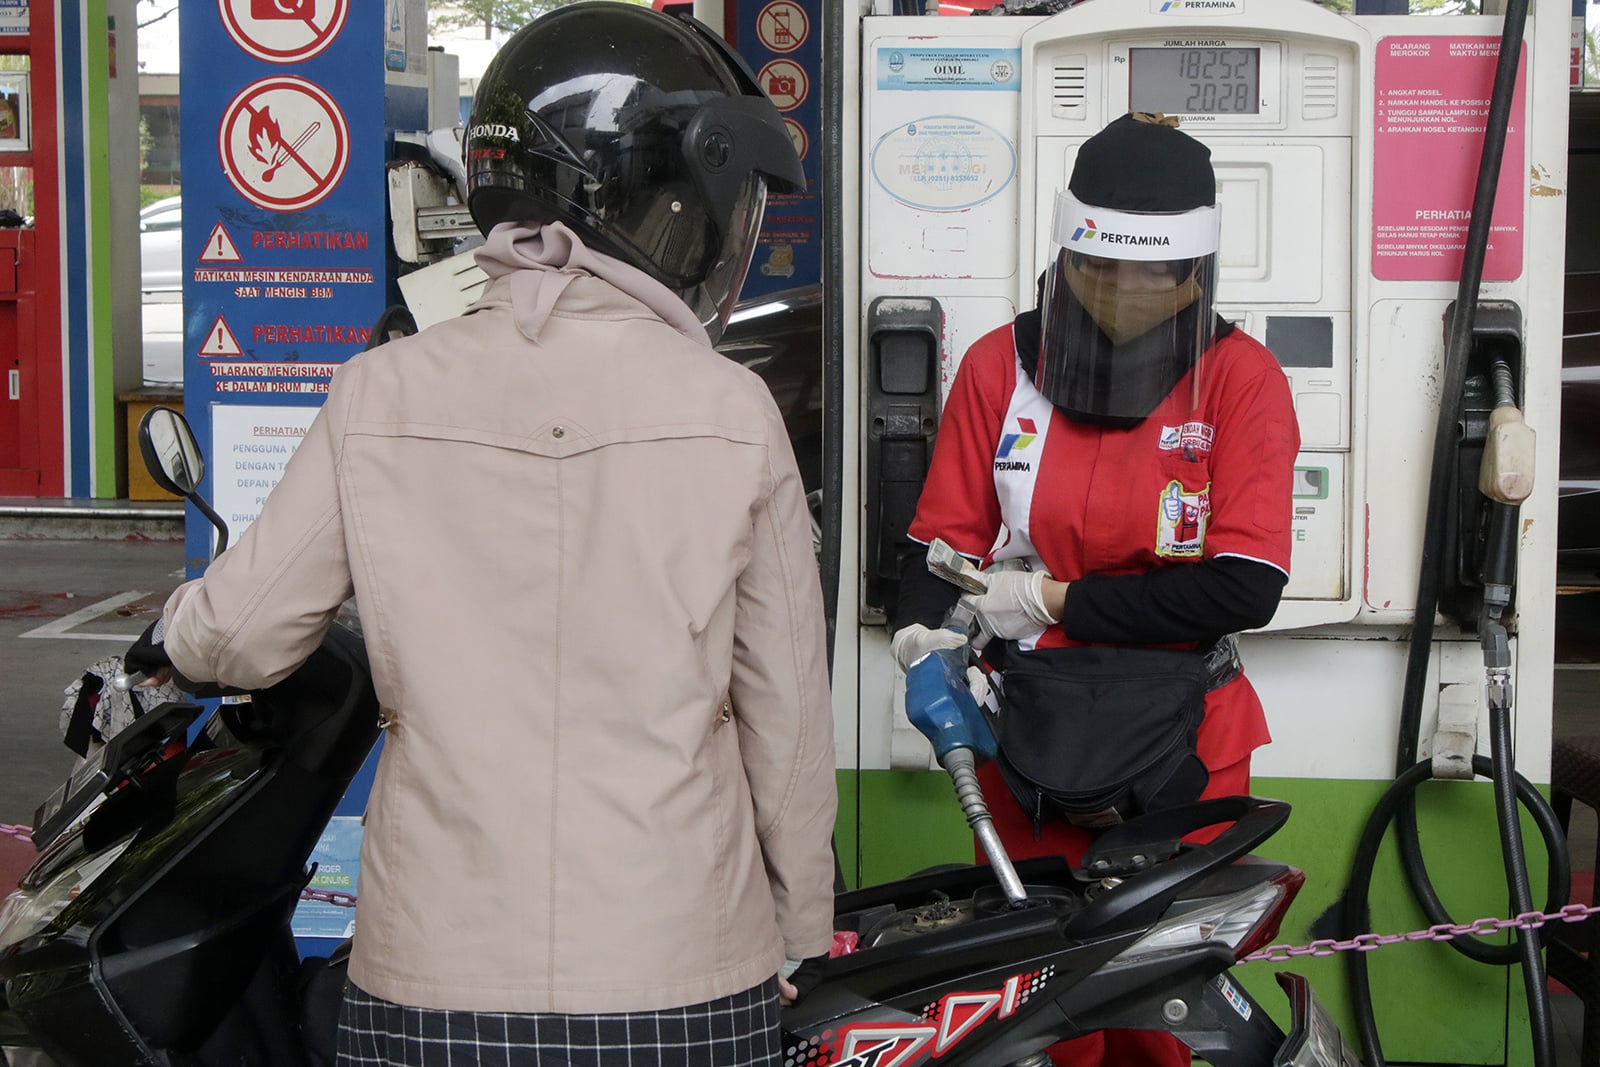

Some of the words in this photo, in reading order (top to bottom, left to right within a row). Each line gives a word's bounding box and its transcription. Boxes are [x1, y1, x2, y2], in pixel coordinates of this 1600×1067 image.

[1185, 1, 1236, 9] PERTAMINA
[1114, 56, 1126, 64] Rp
[1179, 51, 1250, 80] 18252
[934, 65, 966, 74] OIML
[1185, 83, 1249, 112] 2.028
[1261, 99, 1268, 107] L
[470, 124, 520, 142] HONDA
[1415, 210, 1472, 221] PERHATIA
[251, 231, 368, 251] PERHATIKAN
[1100, 231, 1170, 246] PERTAMINA
[194, 271, 240, 282] MATIKAN
[243, 271, 275, 282] MESIN
[279, 271, 343, 283] KENDARAAN
[345, 272, 375, 284] ANDA
[234, 287, 261, 298] SAAT
[264, 287, 307, 299] MENGISI
[310, 287, 334, 299] BBM
[252, 325, 371, 344] PERHATIKAN
[210, 365, 264, 377] DILARANG
[266, 366, 334, 378] MENGISIKAN
[215, 381, 229, 392] KE
[232, 381, 268, 392] DALAM
[271, 382, 302, 393] DRUM
[310, 382, 330, 393] JER
[253, 426, 307, 437] PERHATIAN
[233, 444, 287, 454] PENGGUNA
[235, 462, 275, 471] DENGAN
[994, 461, 1031, 473] PERTAMINA
[237, 479, 269, 488] DEPAN
[319, 865, 342, 873] RIDER
[321, 875, 350, 885] ONLINE
